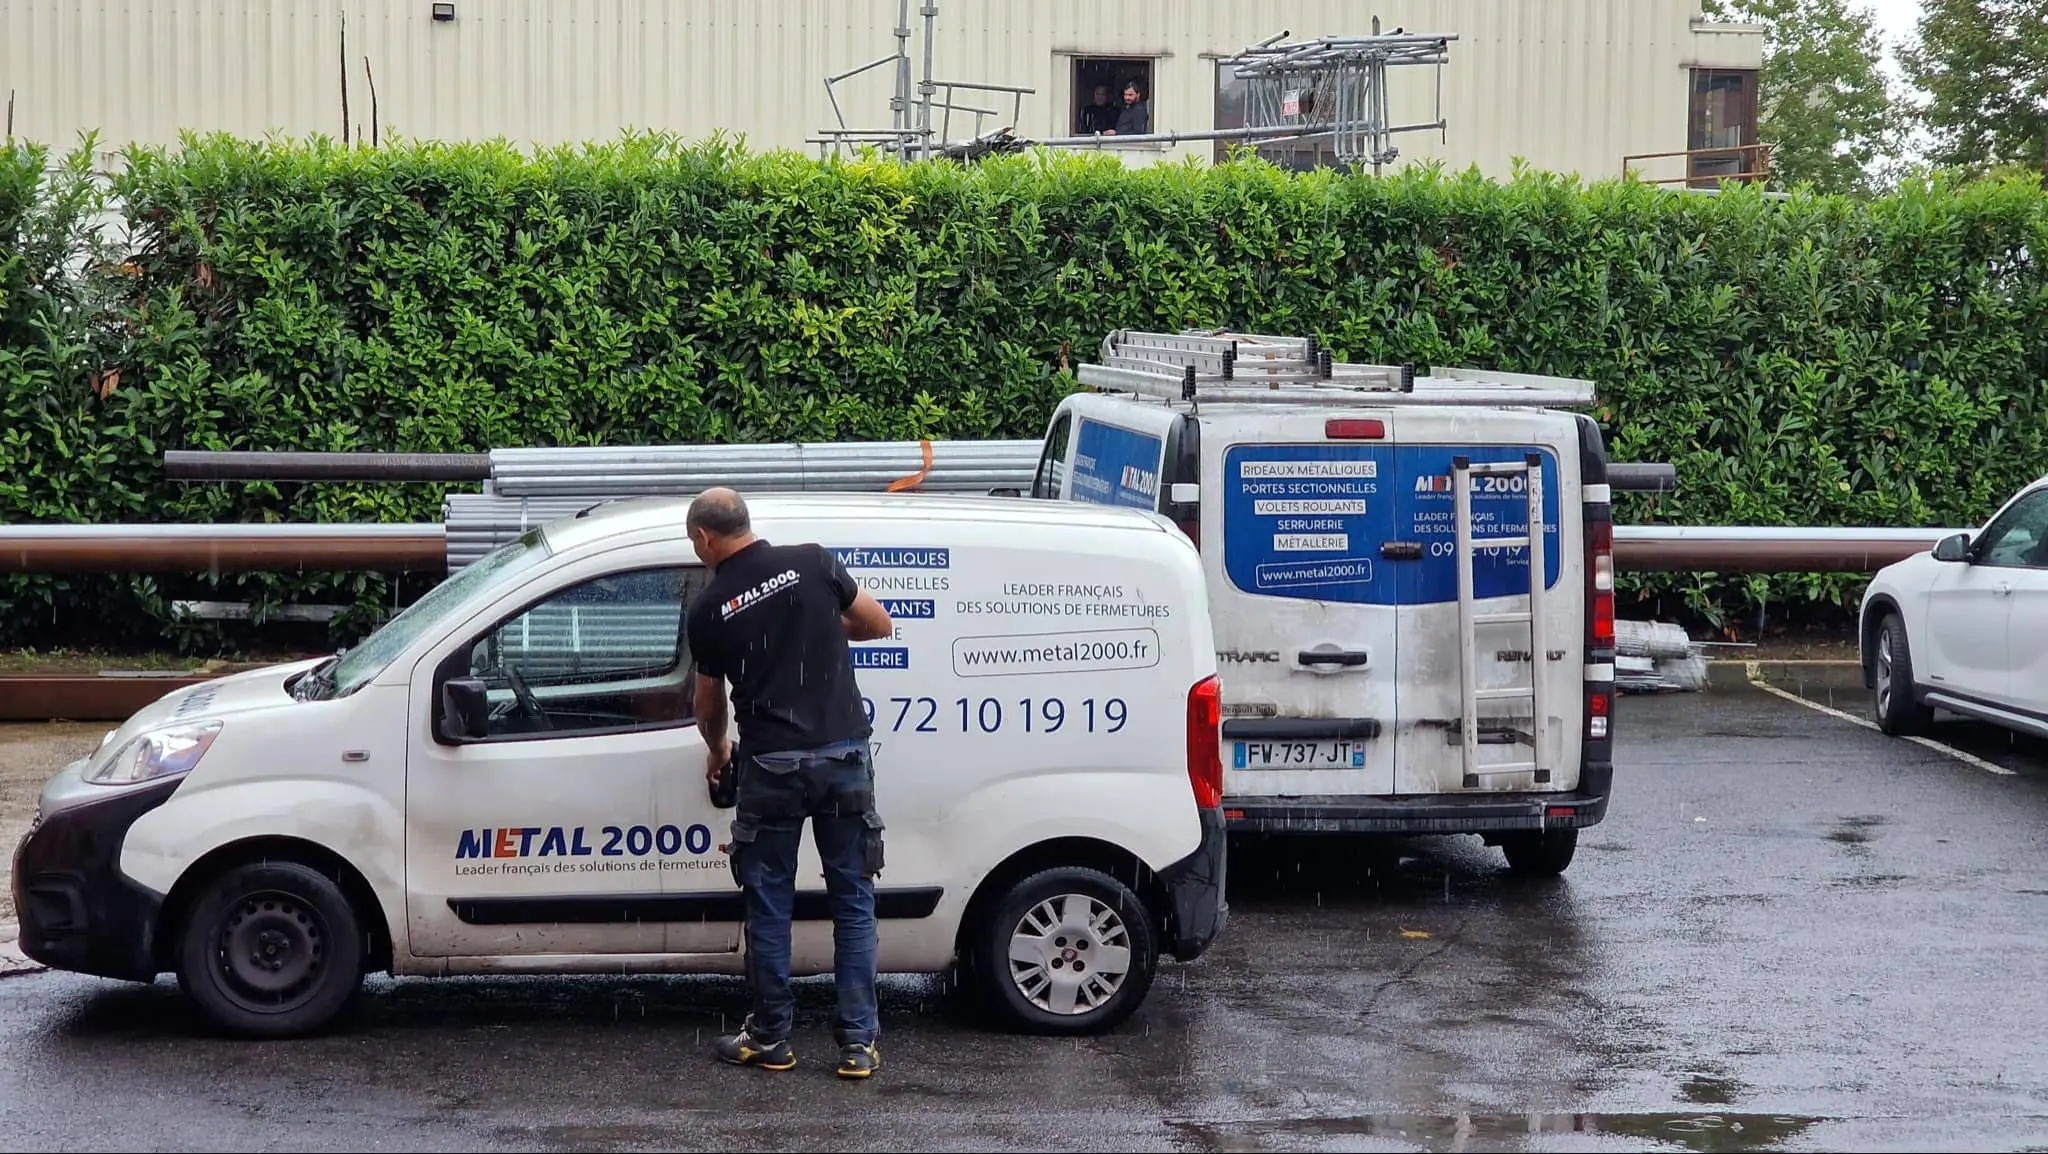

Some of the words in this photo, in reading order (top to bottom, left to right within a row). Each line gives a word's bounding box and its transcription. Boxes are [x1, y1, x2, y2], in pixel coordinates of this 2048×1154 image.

[1243, 465, 1294, 476] RIDEAUX
[1298, 462, 1375, 476] MÉTALLIQUES
[1242, 483, 1285, 494] PORTES
[1288, 483, 1377, 494] SECTIONNELLES
[1256, 501, 1300, 512] VOLETS
[1303, 501, 1364, 512] ROULANTS
[1278, 519, 1344, 530] SERRURERIE
[1413, 512, 1448, 521] LEADER
[1413, 524, 1431, 533] DES
[1487, 524, 1499, 533] DE
[1278, 535, 1345, 549] MÉTALLERIE
[1430, 541, 1454, 557] 09
[838, 547, 947, 566] MÉTALLIQUES
[1262, 563, 1366, 581] www.metal2000.fr
[856, 576, 950, 590] TIONNELLES
[1003, 583, 1054, 597] LEADER
[1058, 584, 1123, 600] FRANÇAIS
[721, 587, 761, 616] METAL
[956, 601, 982, 614] DES
[985, 601, 1061, 616] SOLUTIONS
[1064, 603, 1082, 616] DE
[1086, 603, 1170, 618] FERMETURES
[854, 651, 903, 666] LLERIE
[963, 639, 1148, 665] www.metal2000.fr
[890, 697, 937, 732] 72
[955, 697, 1003, 733] 10
[1019, 697, 1066, 733] 19
[1081, 697, 1129, 733] 19
[455, 827, 593, 859] METAL
[455, 863, 499, 876] Leader
[502, 862, 551, 877] français
[553, 861, 576, 874] des
[579, 860, 636, 873] solutions
[639, 859, 656, 872] de
[658, 858, 728, 871] fermetures
